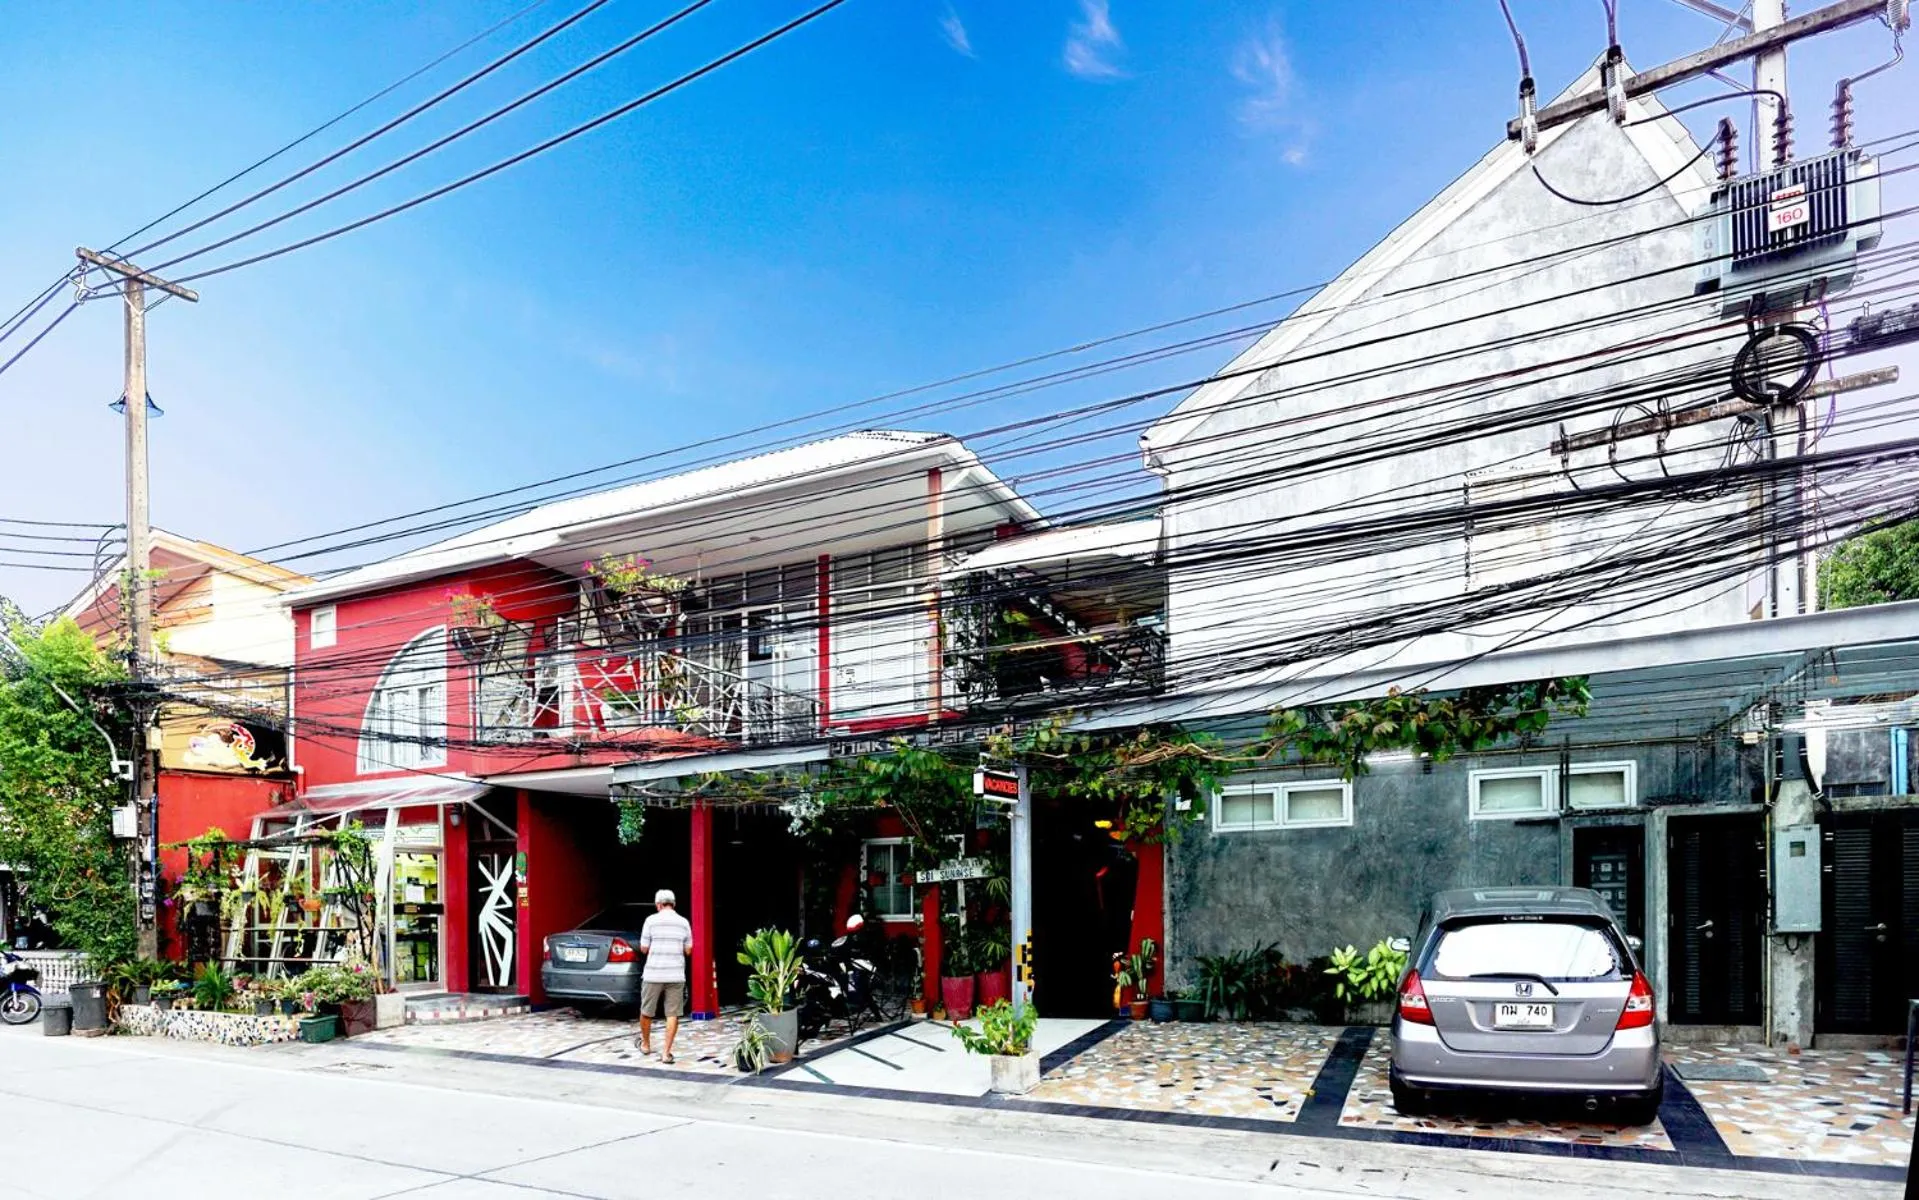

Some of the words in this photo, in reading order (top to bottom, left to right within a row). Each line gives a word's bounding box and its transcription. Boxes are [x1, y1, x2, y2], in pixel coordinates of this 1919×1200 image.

[1776, 208, 1803, 225] 160
[920, 870, 934, 881] SOI
[1526, 1005, 1548, 1016] 740
